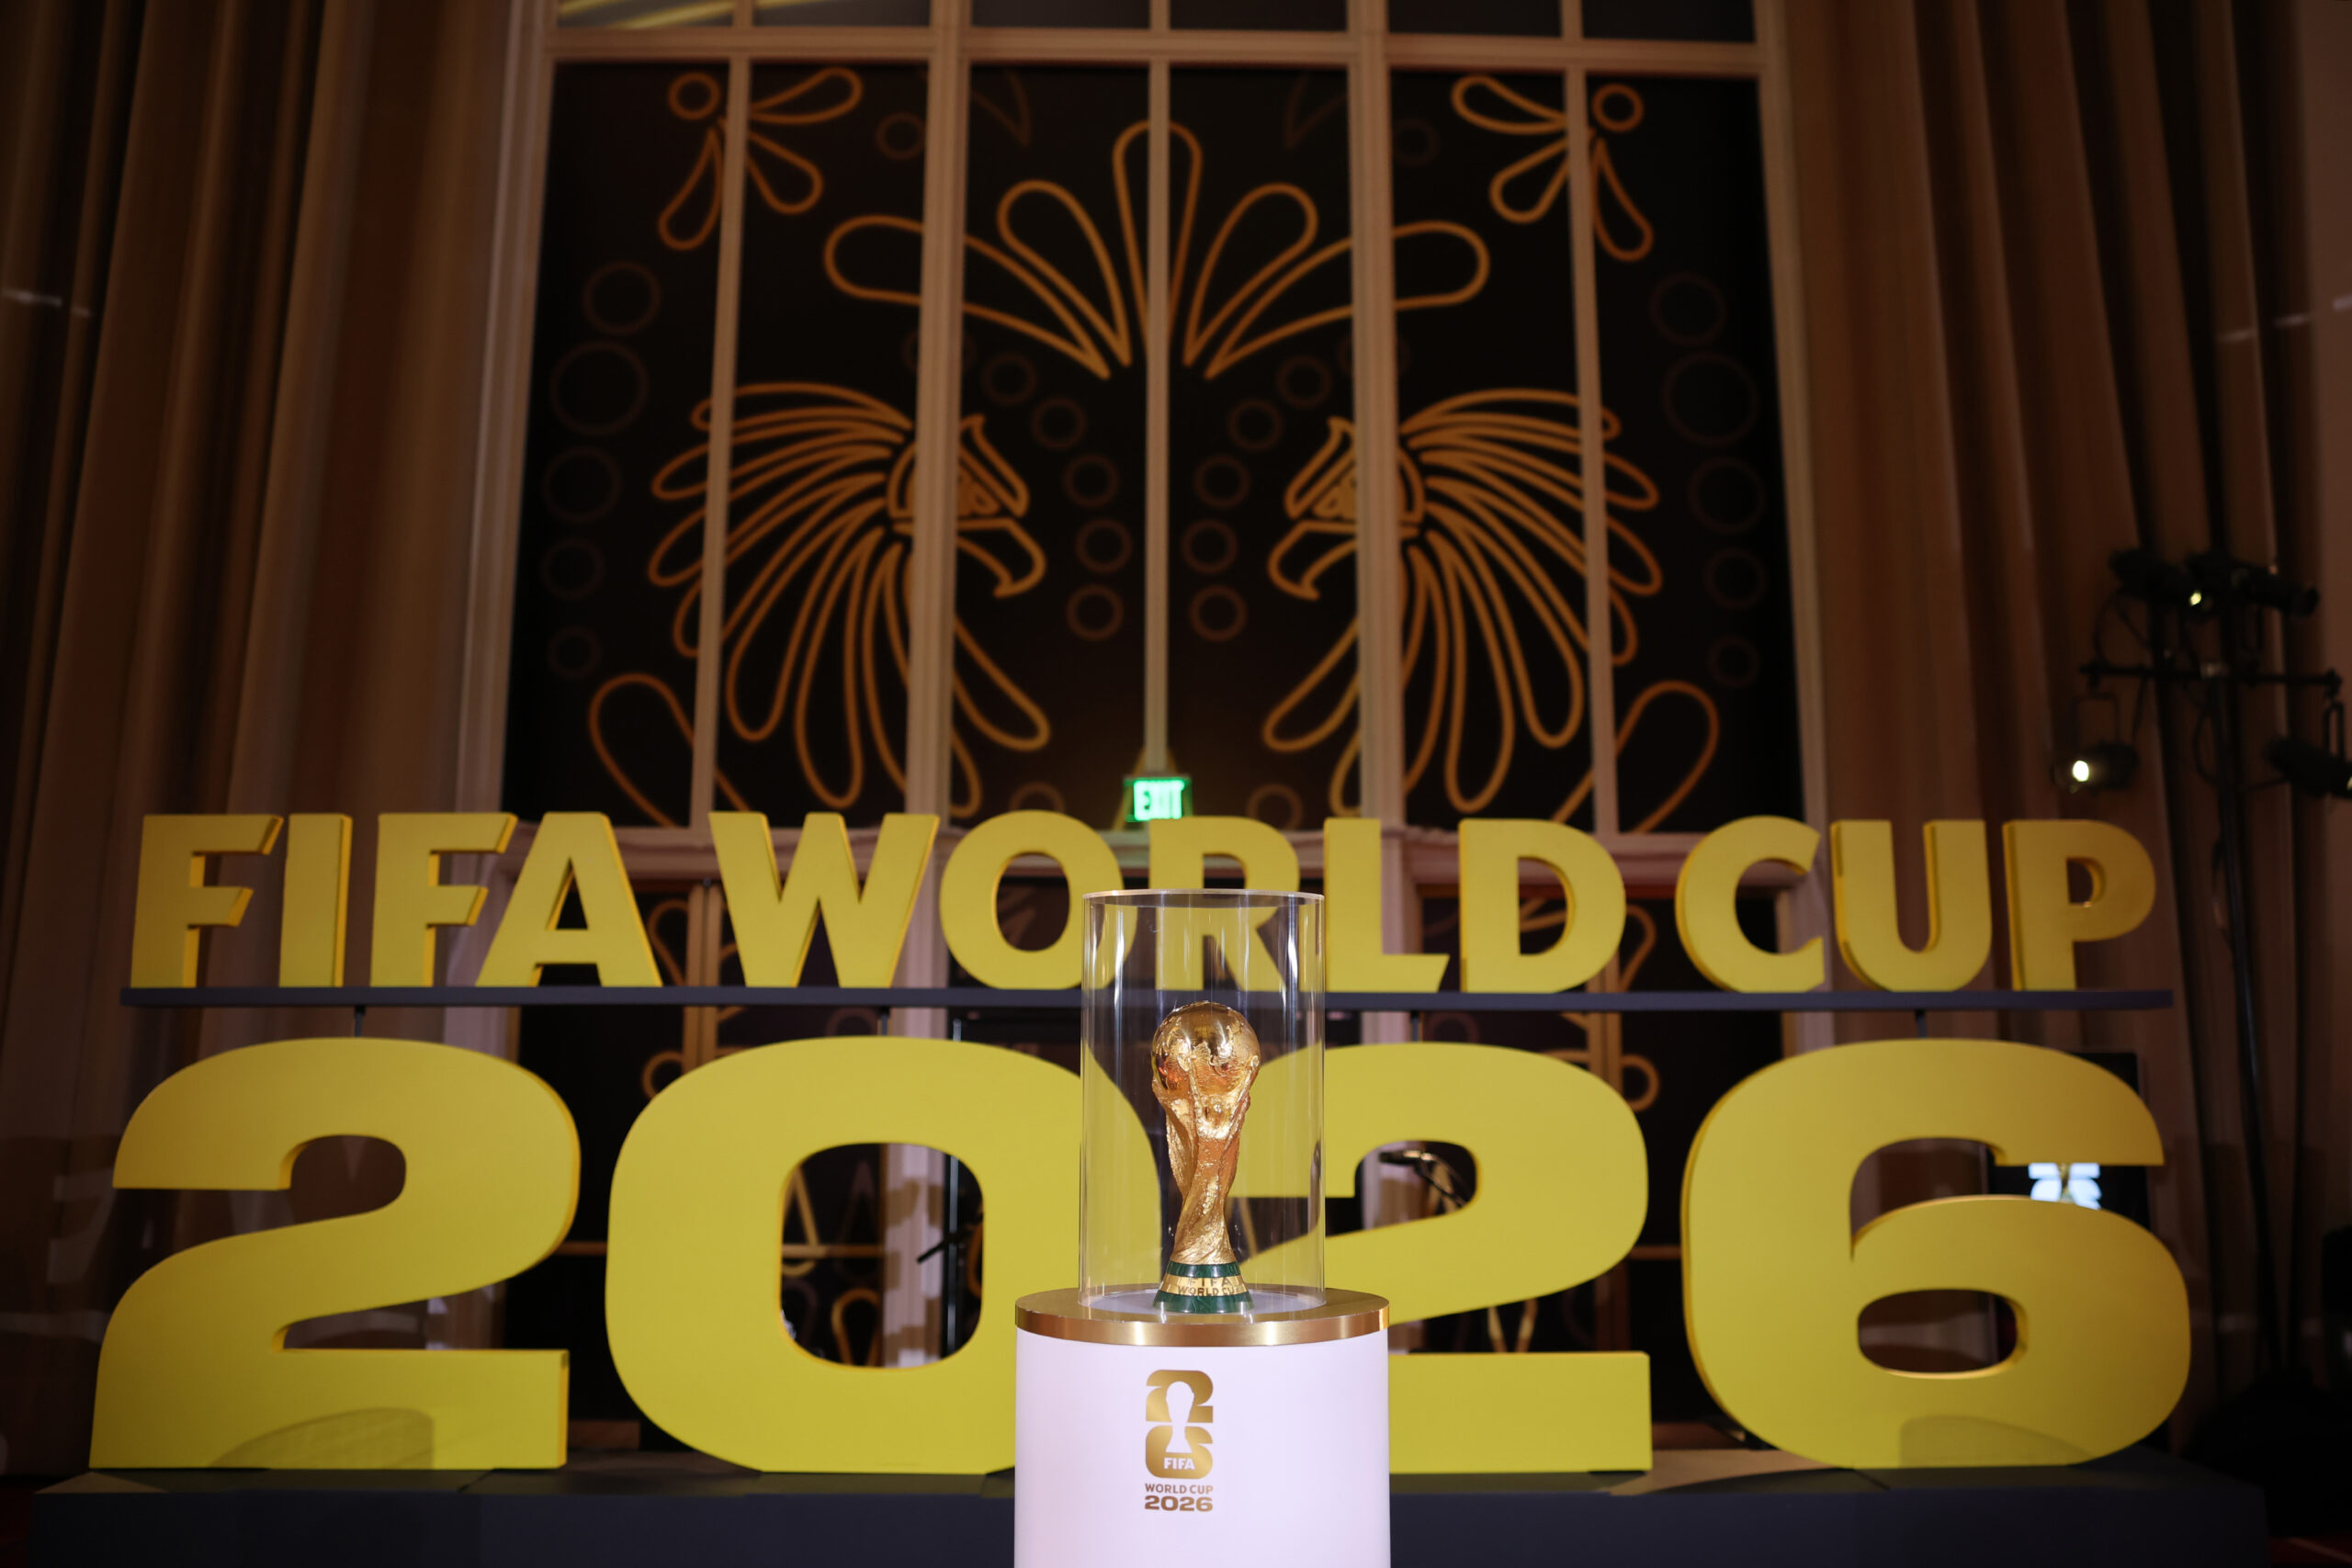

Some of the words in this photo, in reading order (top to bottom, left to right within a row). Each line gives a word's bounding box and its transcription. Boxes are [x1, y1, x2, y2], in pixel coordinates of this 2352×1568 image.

[1133, 779, 1185, 821] EXIT
[130, 812, 663, 987] FIFA
[707, 809, 1625, 994] WORLD
[1675, 815, 2156, 993] CUP
[88, 1037, 2192, 1475] 2026
[1189, 1277, 1233, 1287] FIFA
[1178, 1287, 1218, 1296] WORLD
[1163, 1457, 1195, 1471] FIFA
[1145, 1483, 1187, 1495] WORLD
[1190, 1484, 1214, 1495] CUP
[1145, 1495, 1214, 1512] 2026
